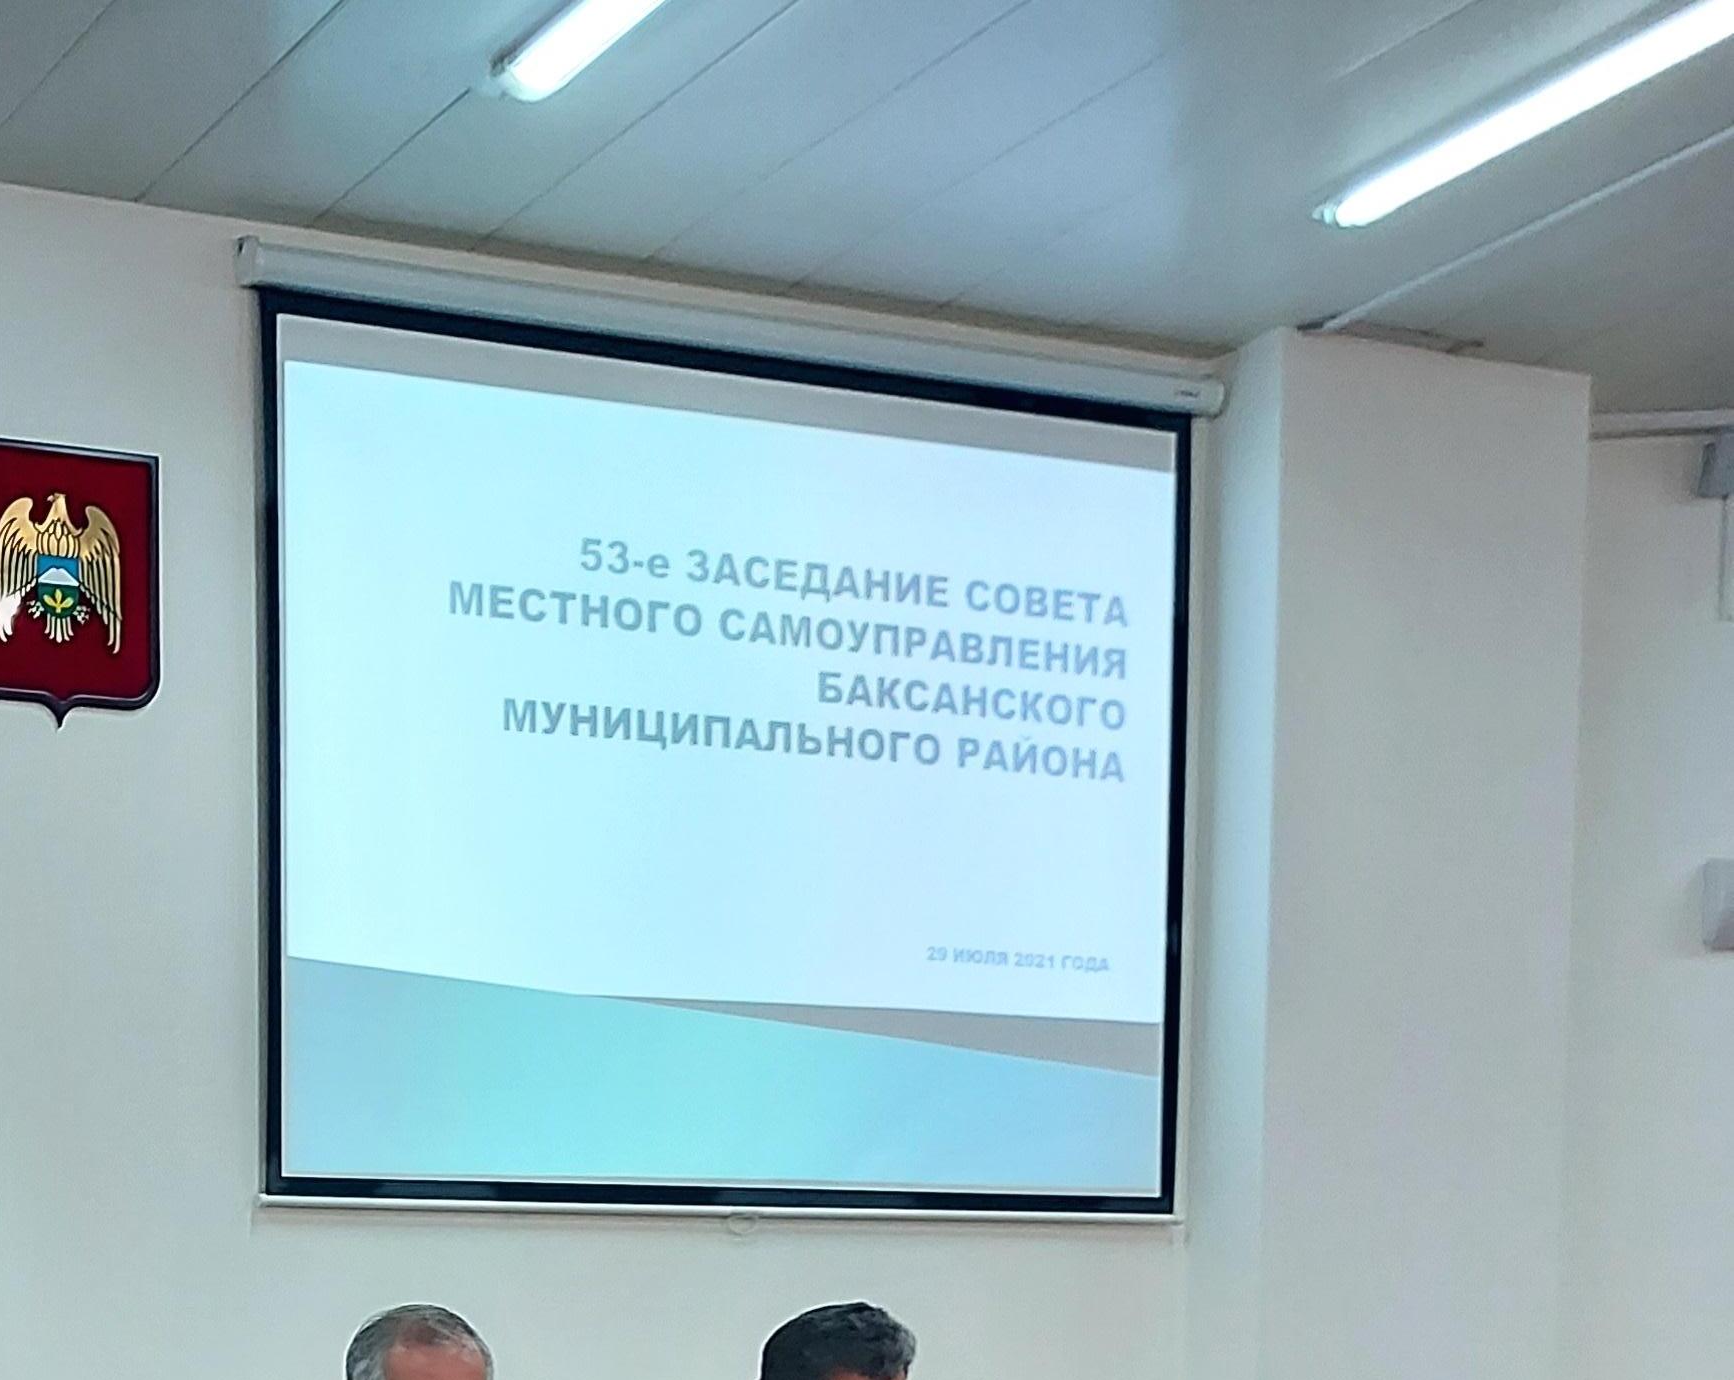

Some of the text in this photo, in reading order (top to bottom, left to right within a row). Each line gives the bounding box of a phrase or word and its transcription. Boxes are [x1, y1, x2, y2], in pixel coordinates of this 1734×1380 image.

[579, 537, 1128, 628] 53-е ЗАСЕДАНИЕ СОВЕТА
[448, 581, 1127, 681] МЕСТНОГО САМОУПРАВЛЕНИЯ
[502, 698, 1125, 783] МУНИЦИПАЛЬНОГО РАЙОНА
[817, 671, 1125, 732] БАКСАНСКОГО
[927, 946, 1109, 973] 29 ИЮЛЯ 2021 ГОДА
